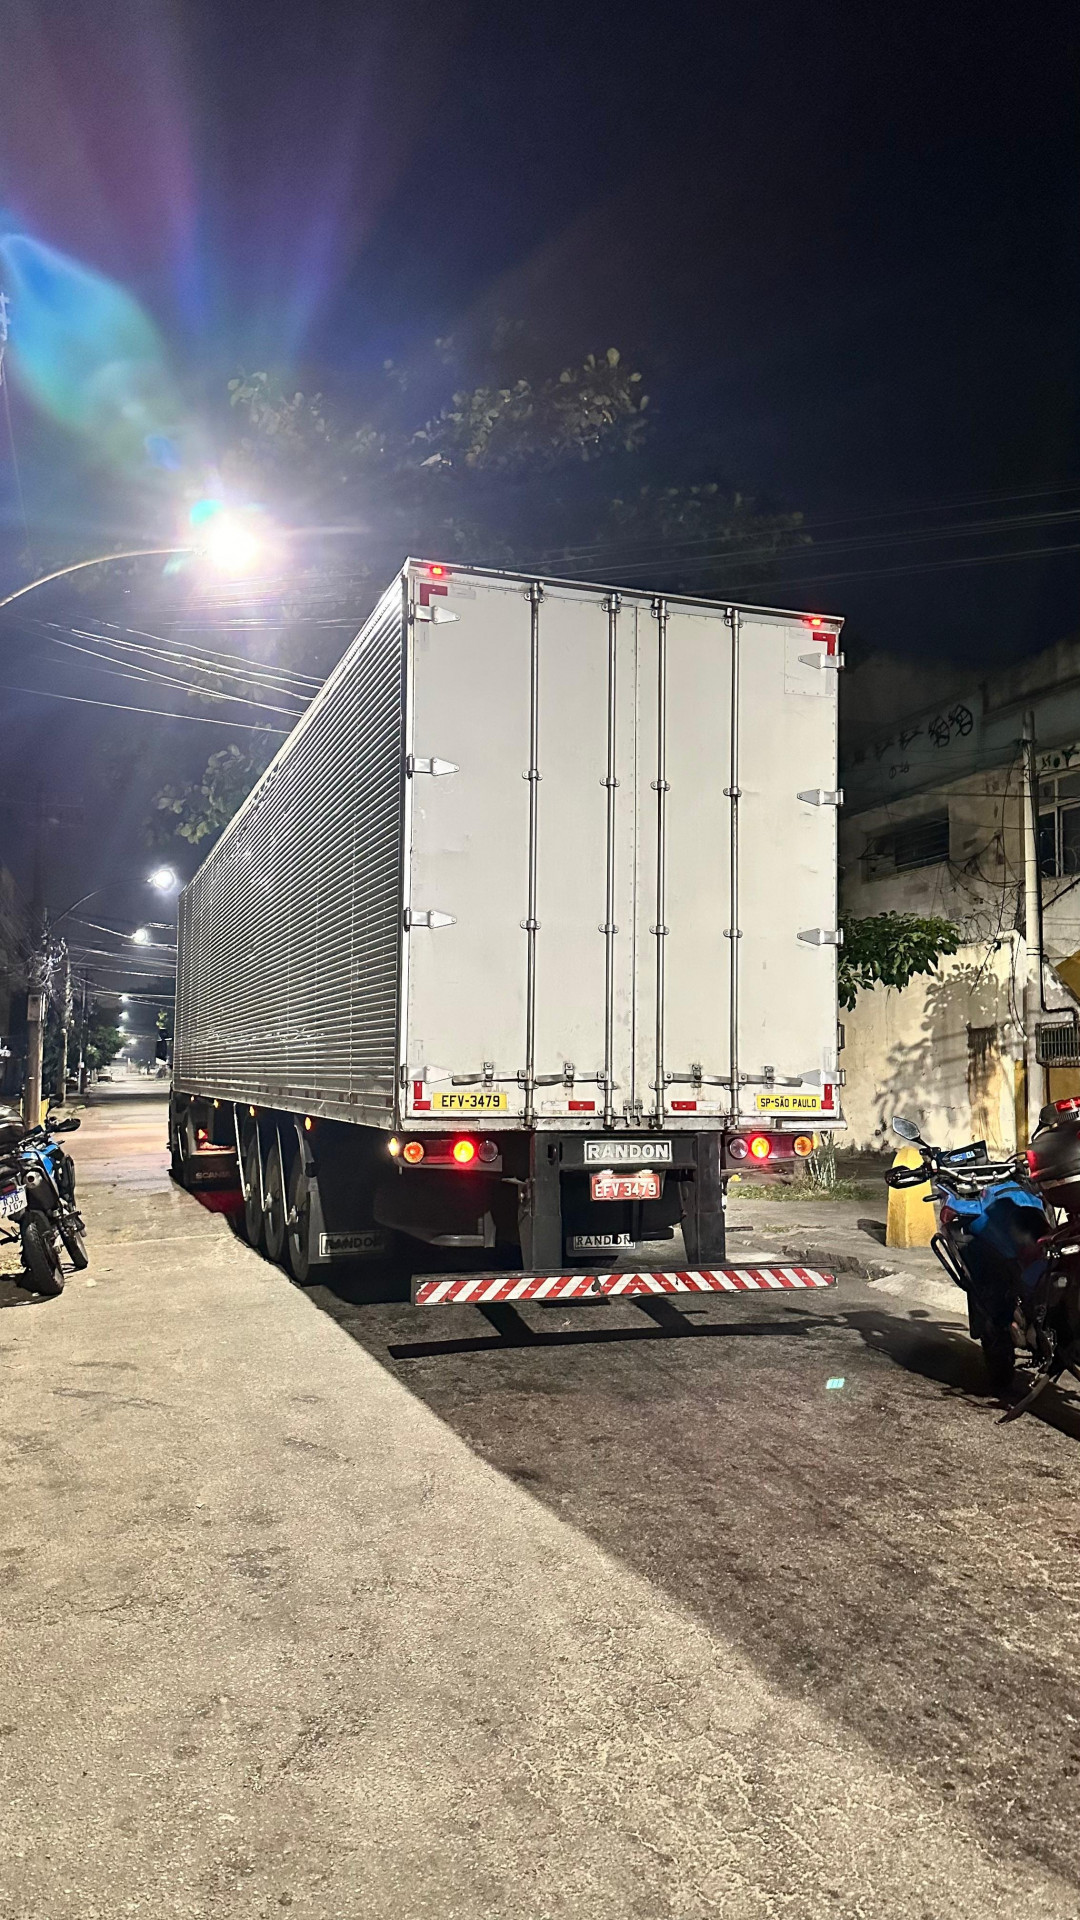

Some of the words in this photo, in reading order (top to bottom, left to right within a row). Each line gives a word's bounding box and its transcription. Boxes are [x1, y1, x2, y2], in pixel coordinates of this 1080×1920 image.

[441, 1095, 500, 1107] EFV-3479
[760, 1096, 789, 1107] SP-SÃO
[792, 1099, 816, 1107] PAULO
[588, 1144, 668, 1158] RANDON
[595, 1183, 619, 1197] EFV
[624, 1182, 656, 1196] 3479
